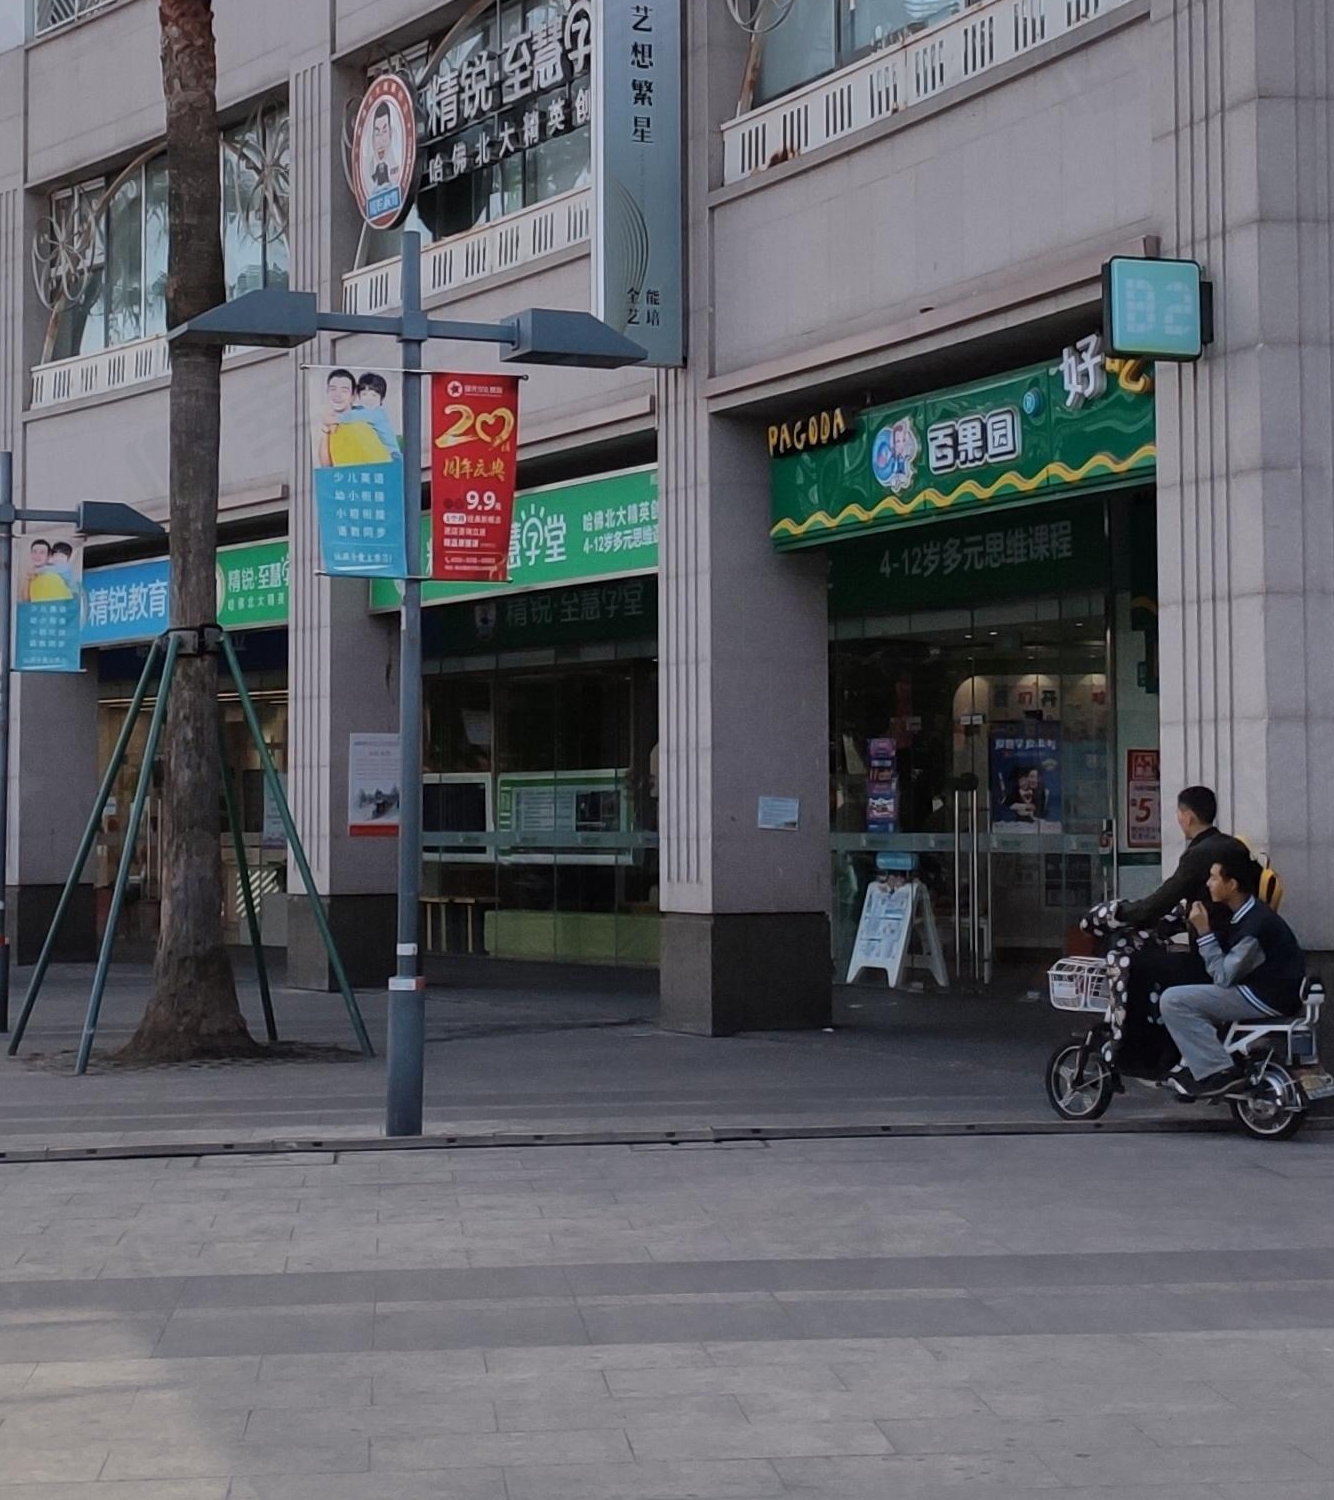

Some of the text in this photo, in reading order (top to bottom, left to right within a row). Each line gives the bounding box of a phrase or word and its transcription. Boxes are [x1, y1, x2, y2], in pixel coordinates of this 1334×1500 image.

[629, 3, 656, 145] 艺想繁星
[768, 407, 846, 457] PAGODA
[927, 408, 1021, 475] 百果园
[878, 520, 1073, 579] 4-12岁多元思维课程
[88, 580, 168, 627] 精锐教育
